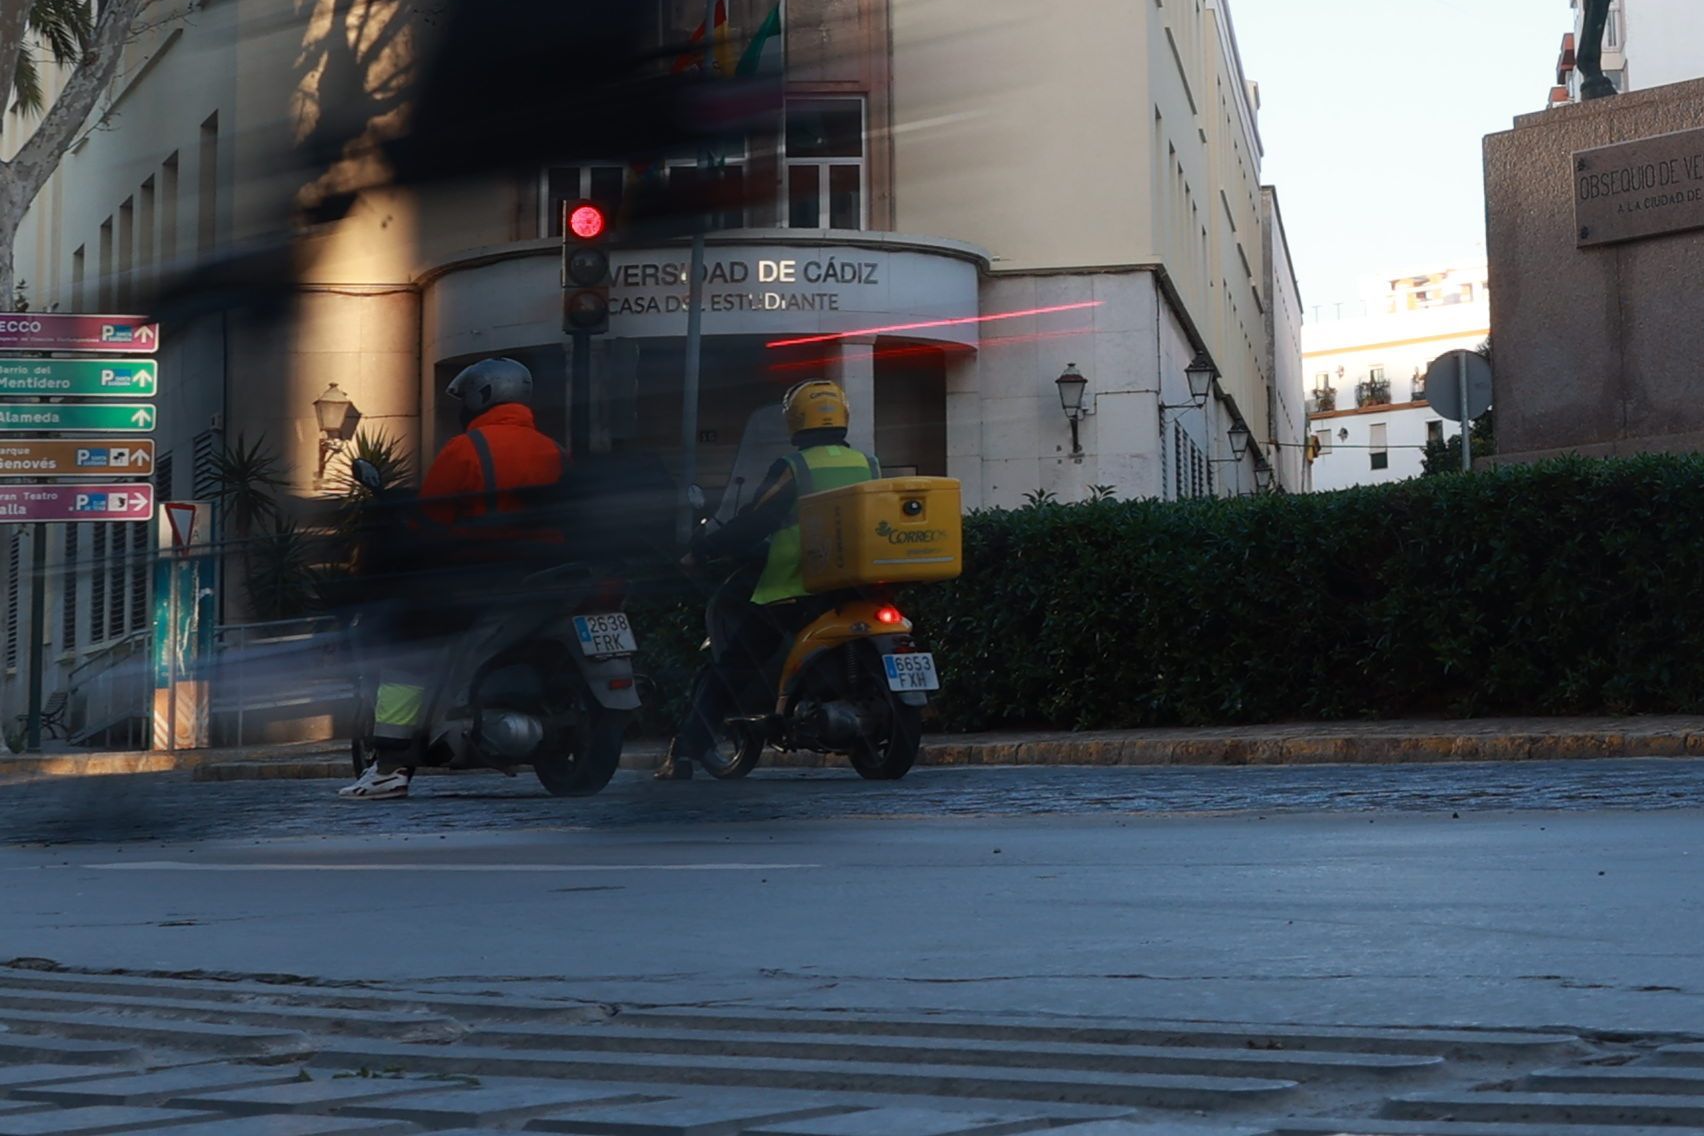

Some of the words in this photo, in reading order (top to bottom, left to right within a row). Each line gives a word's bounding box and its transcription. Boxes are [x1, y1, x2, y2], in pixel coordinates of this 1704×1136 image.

[1580, 164, 1656, 200] OBSEQUIO
[1659, 159, 1680, 186] DE
[1627, 202, 1642, 213] LA
[1644, 191, 1684, 209] CIUDAD
[1687, 188, 1701, 202] DE
[758, 260, 796, 283] DE
[803, 256, 879, 285] CÁDIZ
[608, 296, 661, 314] CASA
[711, 292, 839, 312] ESTUDIANTE
[34, 365, 51, 374] del
[24, 492, 58, 500] Teatro
[587, 615, 628, 633] 2638
[593, 633, 625, 652] FRK
[895, 656, 931, 671] 6653
[899, 672, 928, 688] FXH
